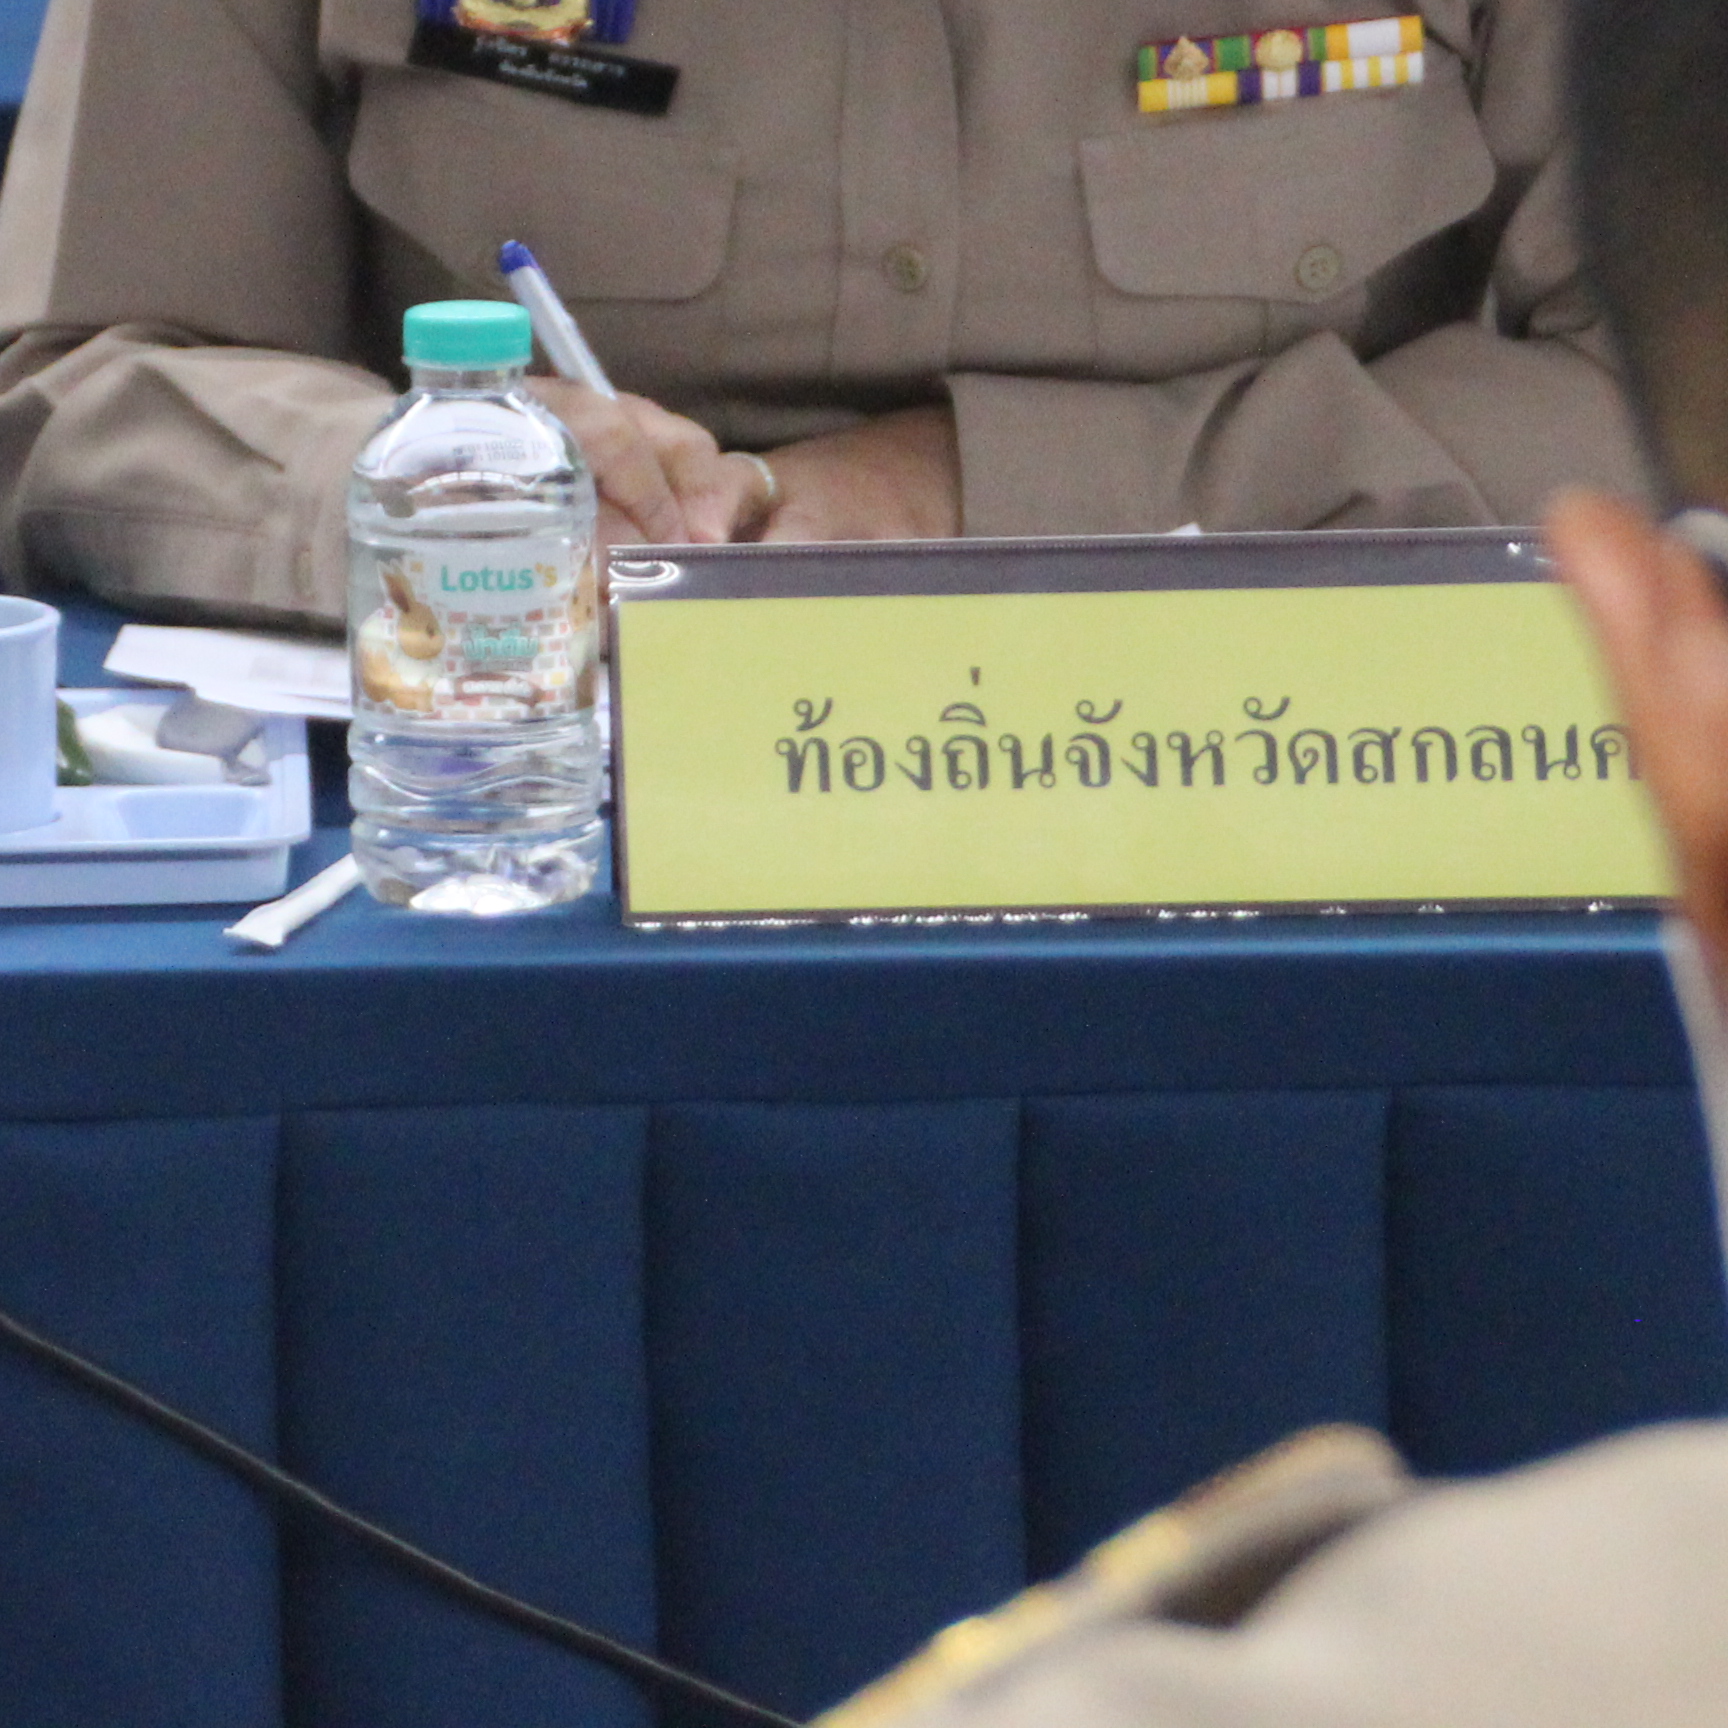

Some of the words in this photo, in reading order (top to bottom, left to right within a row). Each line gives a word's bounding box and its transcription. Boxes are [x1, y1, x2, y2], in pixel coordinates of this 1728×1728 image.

[440, 563, 559, 592] Lotus's
[773, 666, 1641, 796] ท้องถิ่นจังหวัดสกลนค
